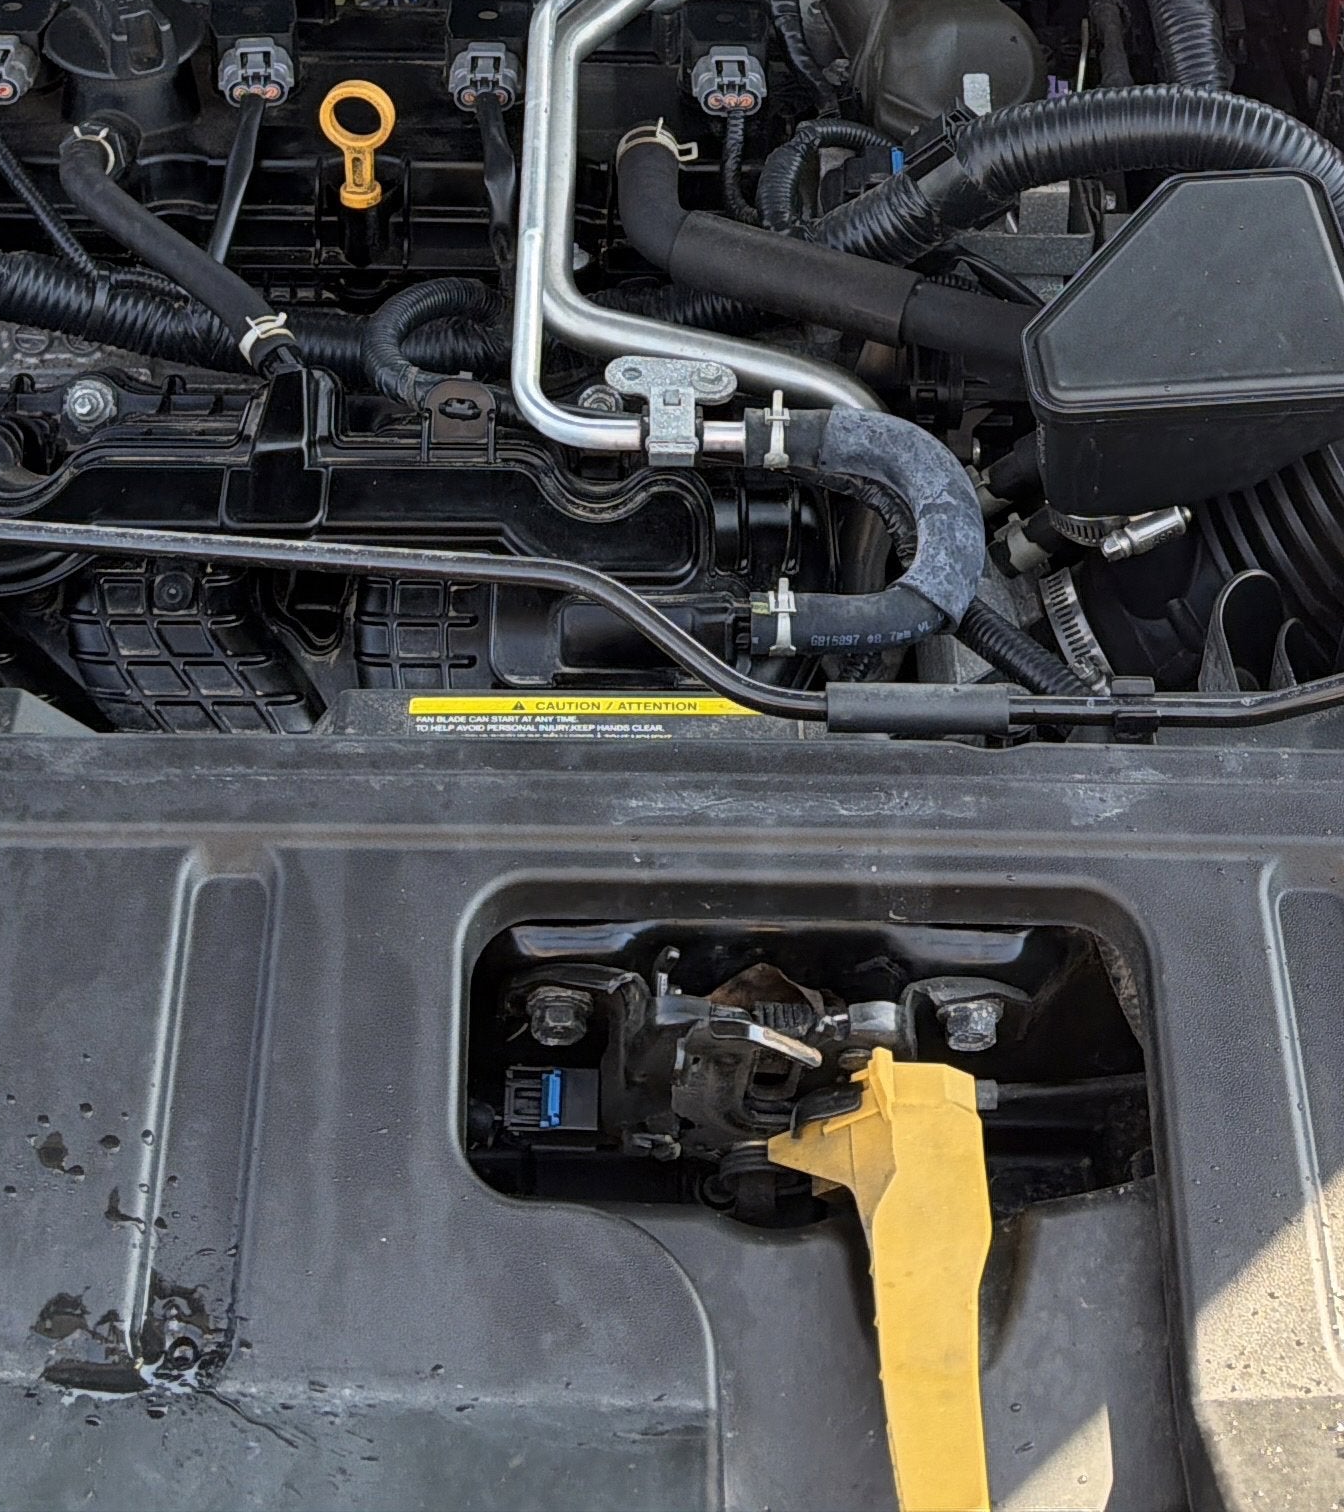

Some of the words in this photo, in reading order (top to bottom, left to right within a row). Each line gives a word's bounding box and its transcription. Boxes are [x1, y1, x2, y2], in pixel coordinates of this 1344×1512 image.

[535, 701, 601, 711] CAUTION
[618, 701, 698, 711] ATTENTION
[415, 715, 434, 723] FAN
[436, 715, 467, 723] BLADE
[468, 715, 489, 723] CAN
[490, 715, 519, 723] START
[521, 715, 533, 723] AT
[534, 715, 554, 723] ANY
[415, 724, 428, 732] TO
[430, 724, 455, 732] HELP
[456, 724, 485, 732] AVOID
[486, 724, 537, 732] PERSONAL
[596, 724, 630, 732] HANDS
